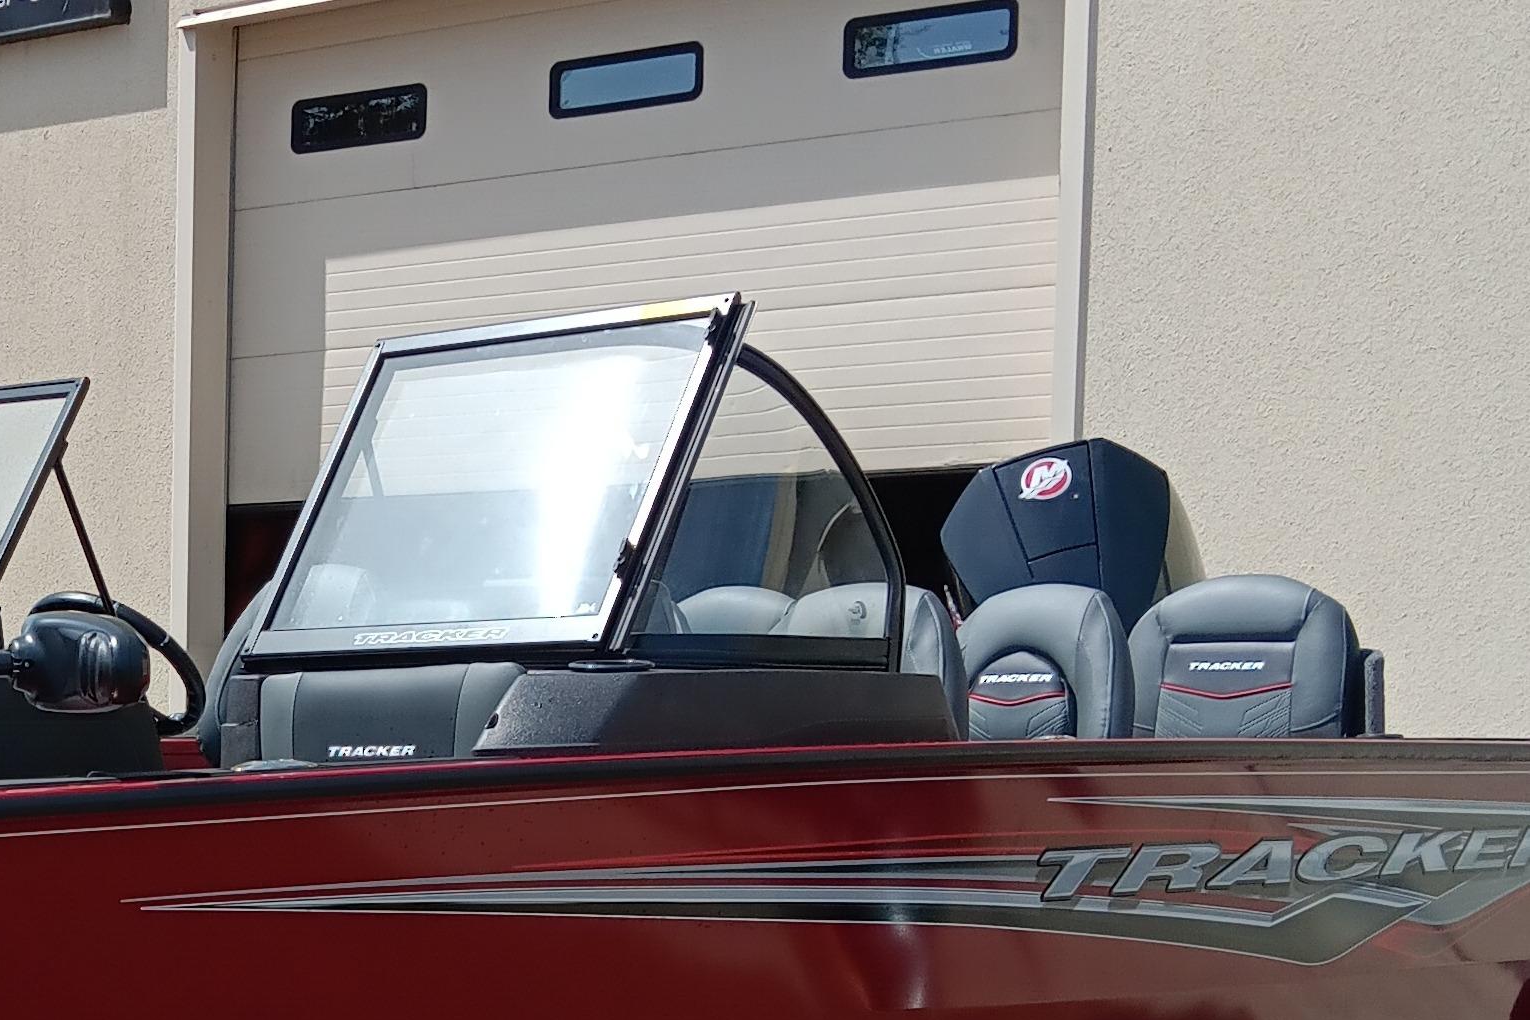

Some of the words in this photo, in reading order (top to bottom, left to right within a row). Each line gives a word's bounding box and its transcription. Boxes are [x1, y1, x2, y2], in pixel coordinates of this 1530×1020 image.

[354, 625, 510, 646] TRACKER
[1188, 660, 1265, 671] TRACKER
[979, 672, 1053, 685] TRACKER
[328, 744, 417, 757] TRACKER
